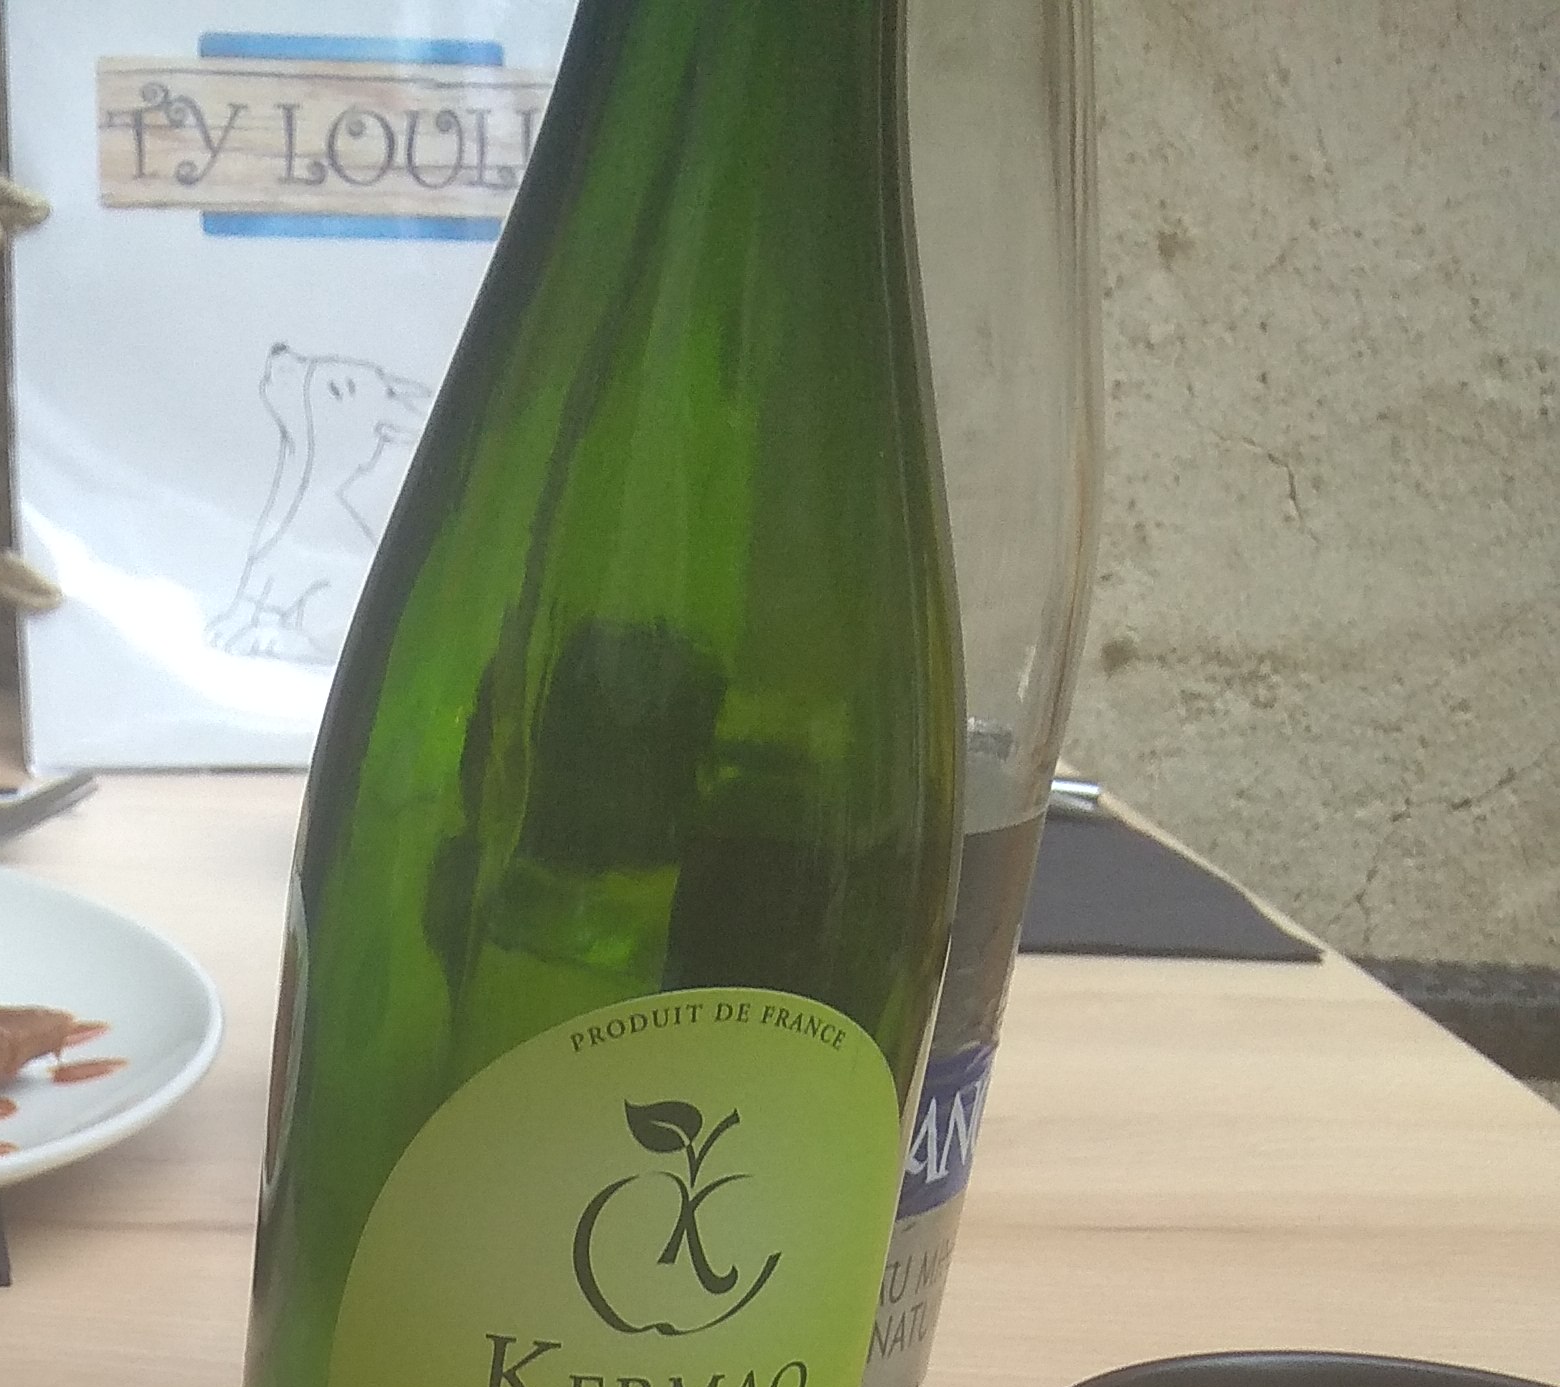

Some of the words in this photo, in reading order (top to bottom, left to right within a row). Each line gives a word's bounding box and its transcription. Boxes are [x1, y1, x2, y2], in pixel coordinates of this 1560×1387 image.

[569, 1003, 703, 1052] PRODUIT
[714, 1003, 751, 1024] DE
[760, 1005, 846, 1051] FRANCE
